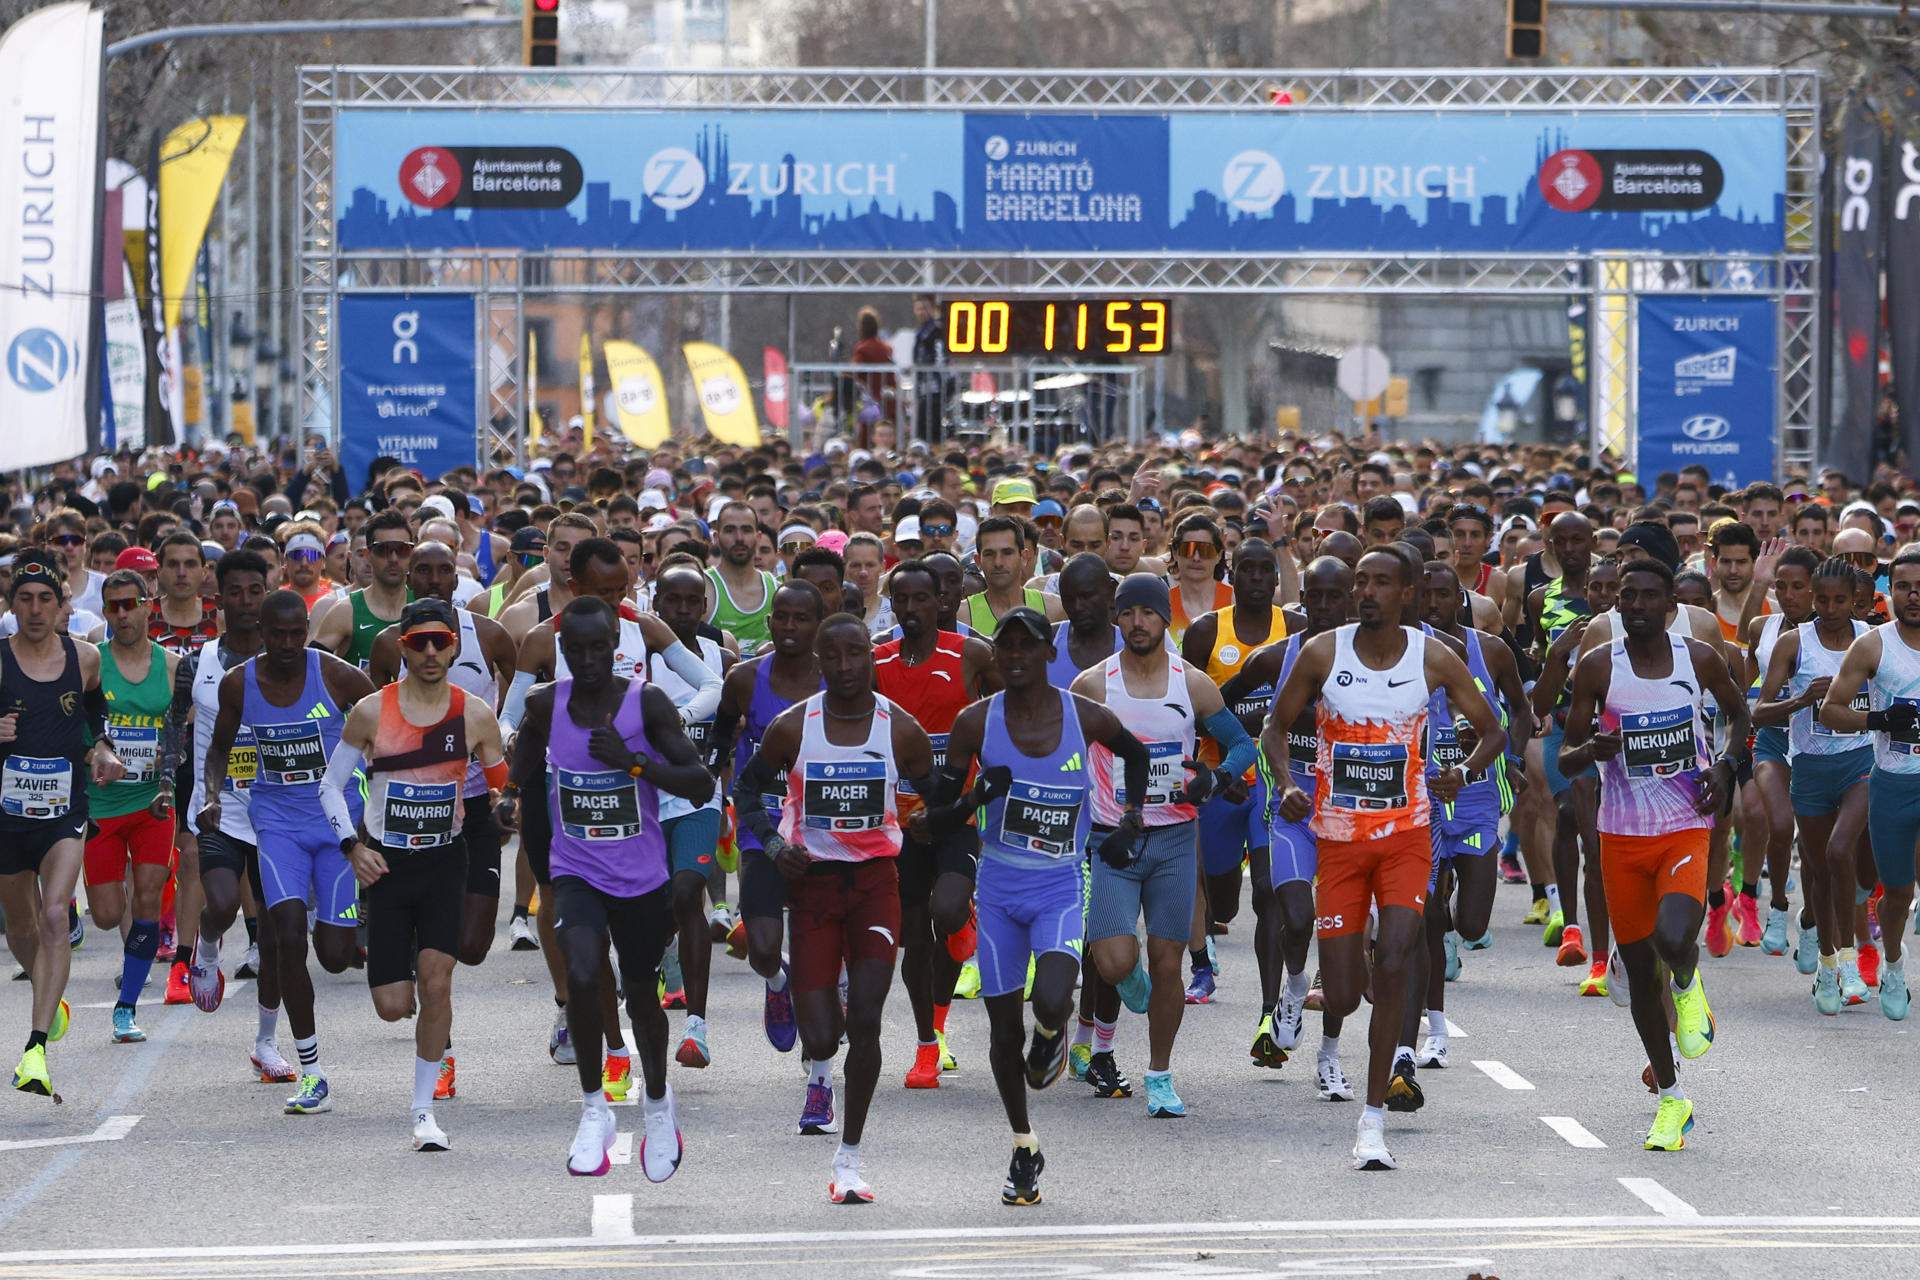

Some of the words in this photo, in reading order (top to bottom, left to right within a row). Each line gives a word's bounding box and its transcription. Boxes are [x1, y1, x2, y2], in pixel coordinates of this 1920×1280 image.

[1016, 140, 1077, 156] ZURICH
[473, 160, 542, 174] Ajuntament
[546, 160, 562, 173] de
[1614, 164, 1684, 177] Ajuntament
[1687, 164, 1703, 175] de
[726, 162, 896, 196] ZURICH
[986, 158, 1093, 191] MARATÓ
[1306, 165, 1475, 198] ZURICH
[473, 175, 562, 192] Barcelona
[1613, 178, 1703, 194] Barcelona
[23, 114, 55, 301] ZURICH
[986, 193, 1141, 222] BARCELONA
[1674, 318, 1739, 332] ZURICH
[377, 436, 438, 450] VITAMIN
[1672, 442, 1739, 455] HYUNDAI
[1651, 713, 1679, 724] ZURICH
[277, 728, 302, 736] ZURICH
[1628, 727, 1690, 750] MEKUANT
[120, 747, 154, 758] MIGUEL
[260, 741, 320, 757] BENJAMIN
[1660, 749, 1667, 759] 2
[285, 758, 296, 767] 20
[1346, 764, 1394, 781] NIGUSU
[15, 777, 58, 791] XAVIER
[585, 777, 615, 785] ZURICH
[1365, 782, 1377, 792] 13
[29, 793, 44, 801] 325
[822, 785, 868, 800] PACER
[1042, 791, 1072, 800] ZURICH
[572, 795, 620, 809] PACER
[839, 802, 850, 812] 21
[390, 804, 451, 819] NAVARRO
[591, 811, 604, 820] 23
[1022, 806, 1070, 826] PACER
[417, 821, 424, 830] 8
[1038, 825, 1051, 835] 24
